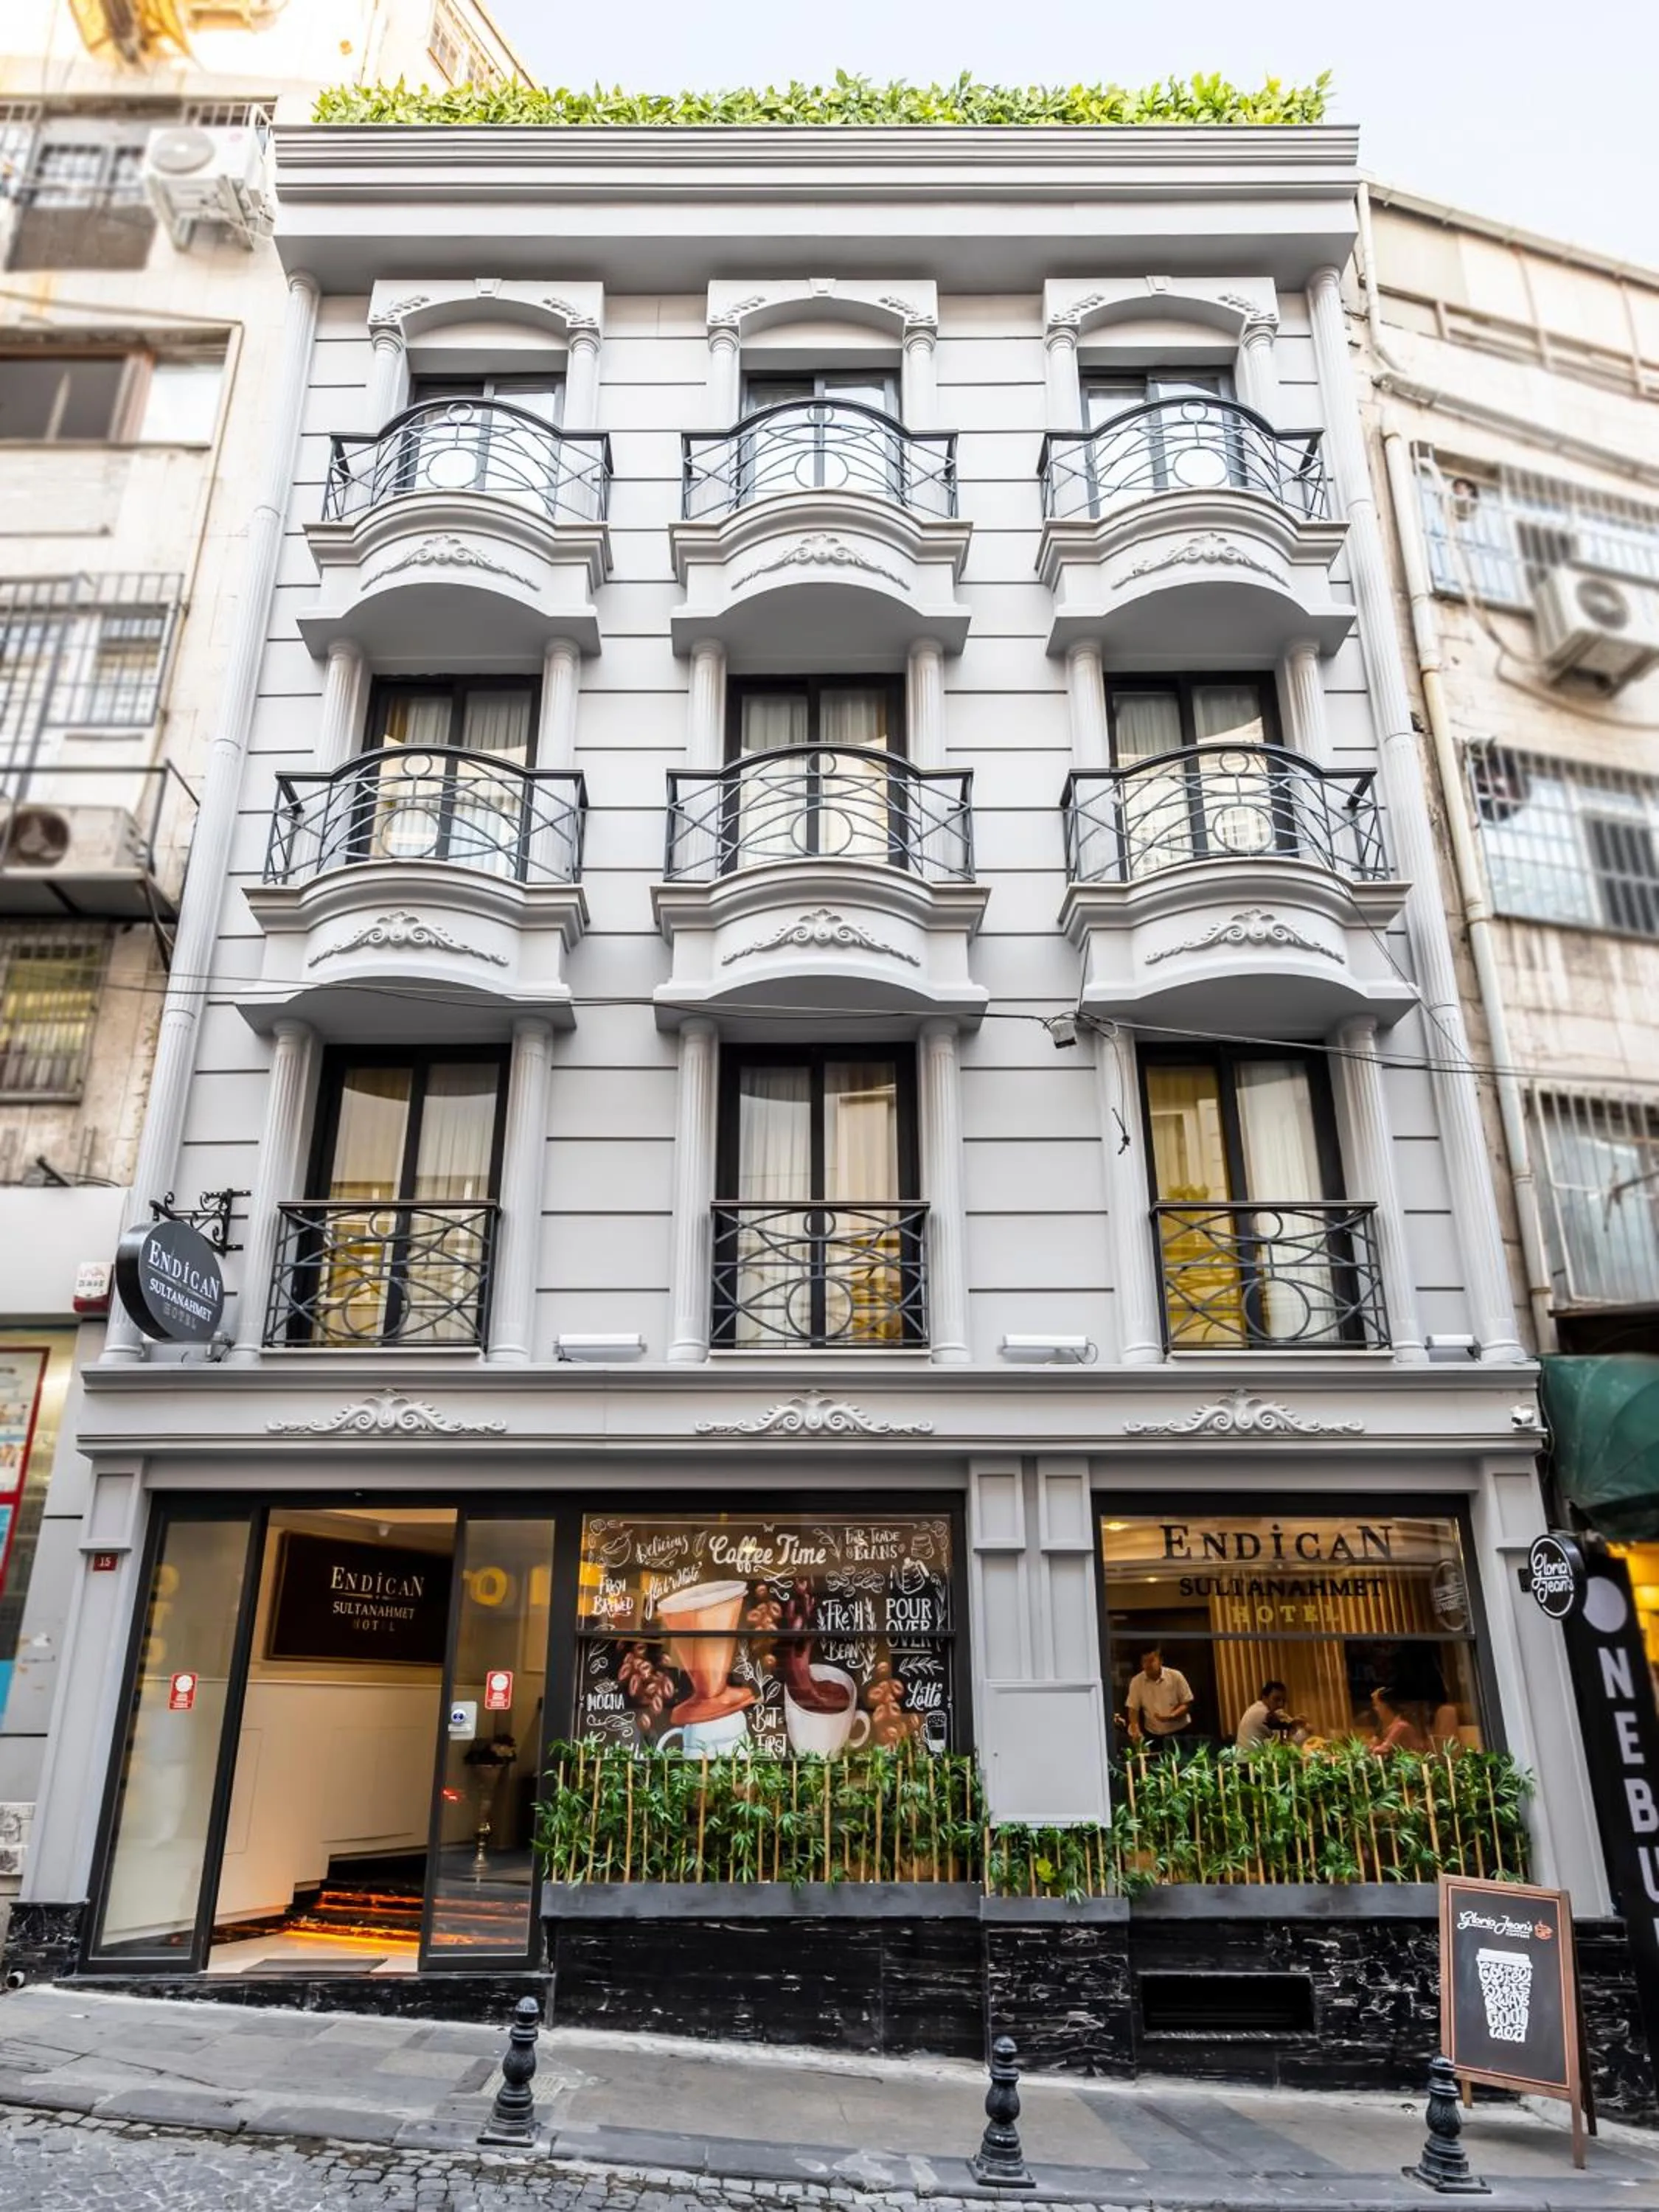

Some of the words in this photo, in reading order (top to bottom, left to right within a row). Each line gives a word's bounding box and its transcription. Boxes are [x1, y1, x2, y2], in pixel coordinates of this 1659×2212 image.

[149, 1277, 212, 1322] SULTANAHMET
[97, 1557, 111, 1567] 15
[709, 1535, 773, 1573] Coffee
[776, 1533, 827, 1565] Time
[853, 1545, 898, 1561] BEANS
[1531, 1553, 1569, 1590] Gloria
[1179, 1577, 1384, 1599] SULTANAHMET
[333, 1601, 415, 1620] SULTANAHMET
[886, 1598, 932, 1620] POUR
[1231, 1605, 1340, 1623] HOTEL
[886, 1621, 931, 1648] OVER
[587, 1694, 625, 1711] MOCHA
[1457, 1910, 1495, 1930] Gloria
